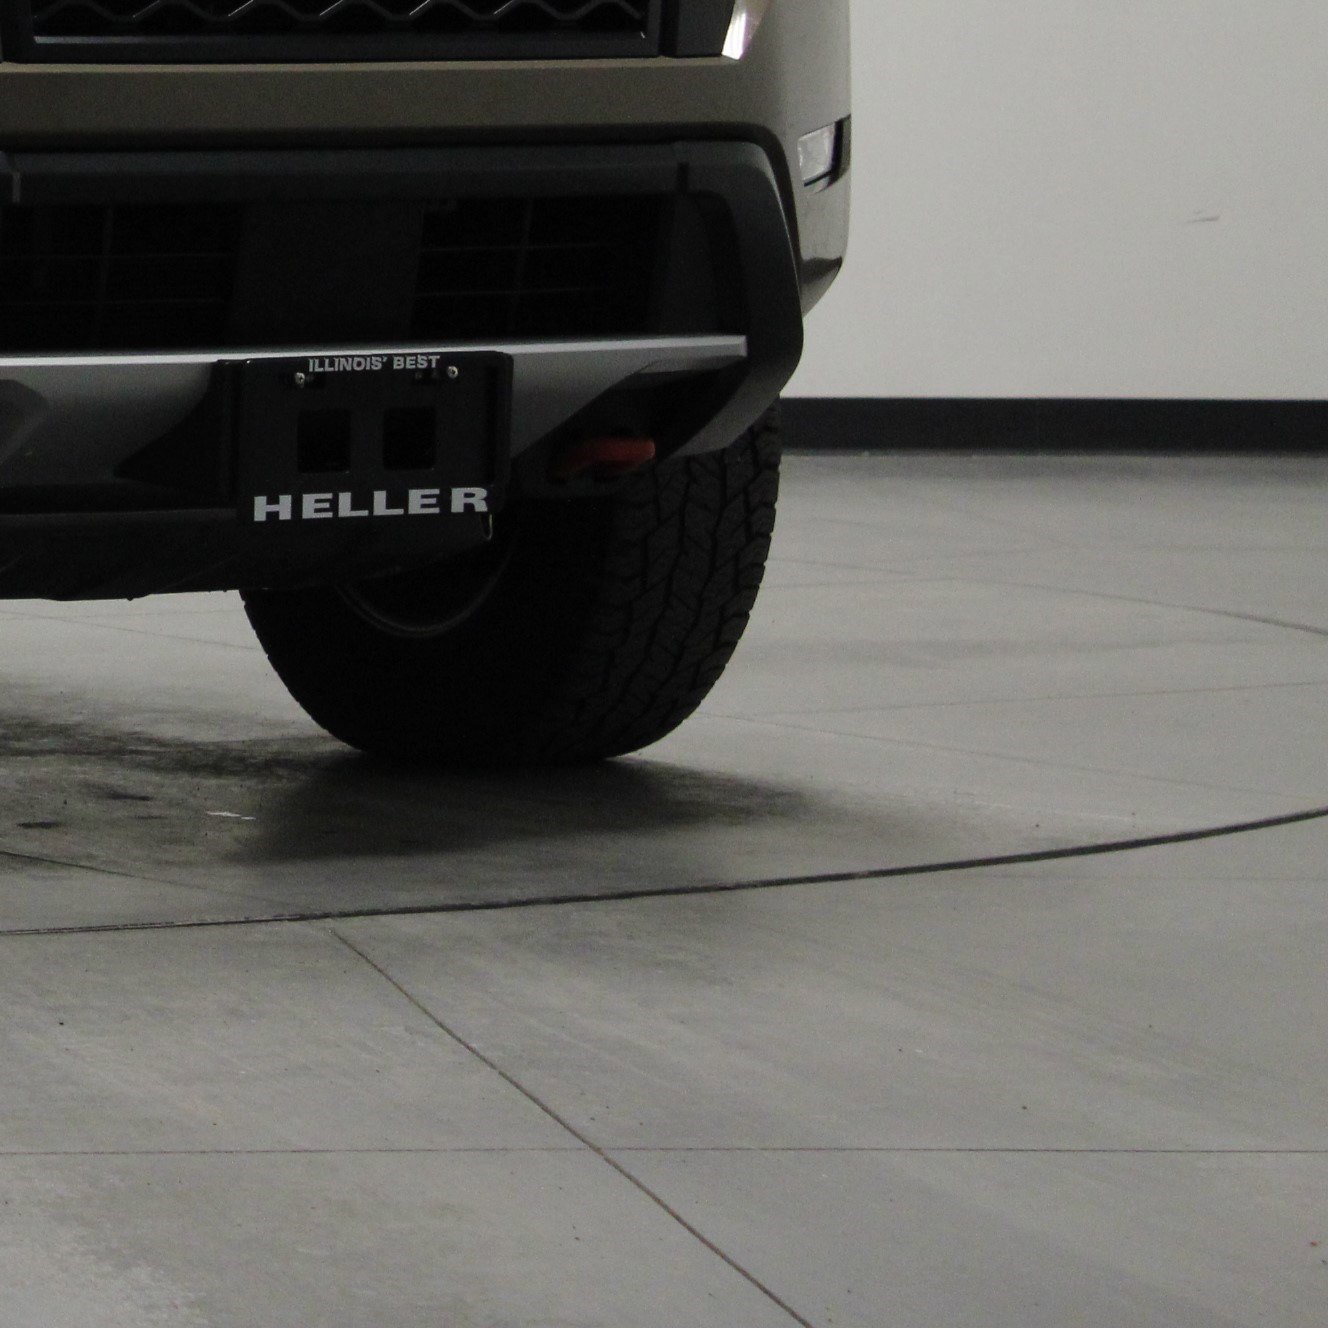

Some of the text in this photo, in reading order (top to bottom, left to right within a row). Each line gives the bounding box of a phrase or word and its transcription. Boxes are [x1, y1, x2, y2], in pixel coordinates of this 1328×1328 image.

[308, 354, 441, 373] ILLINOIS' BEST
[253, 486, 490, 522] HELLER
